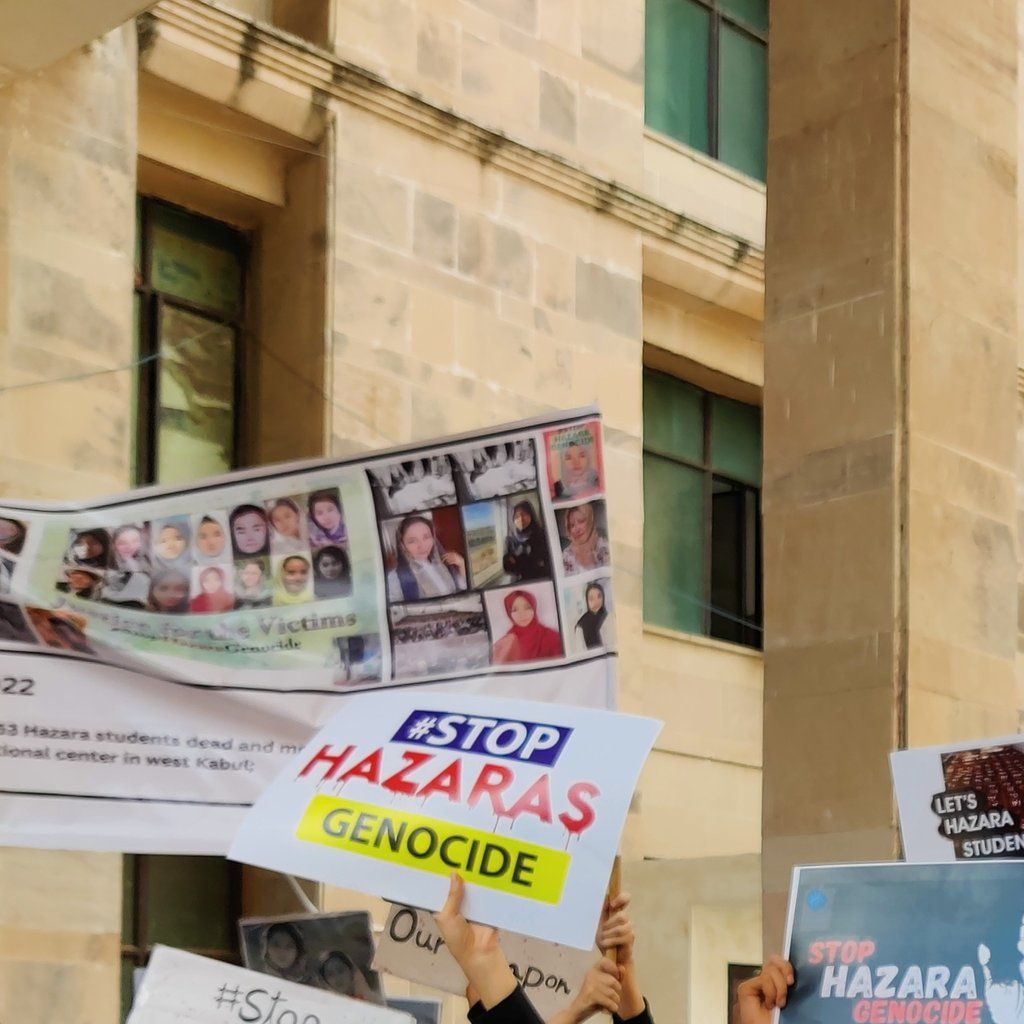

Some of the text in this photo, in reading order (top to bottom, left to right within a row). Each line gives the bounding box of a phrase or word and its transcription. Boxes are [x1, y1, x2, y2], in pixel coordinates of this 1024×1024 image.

[258, 610, 358, 638] Victims
[24, 725, 90, 741] Hazara
[95, 730, 180, 745] students
[187, 735, 233, 751] dead
[239, 740, 274, 754] and
[408, 716, 561, 761] #STOP
[0, 744, 50, 760] ional
[56, 748, 117, 764] center
[123, 752, 141, 765] in
[146, 755, 190, 768] west
[297, 743, 600, 836] HAZARAS
[936, 793, 978, 814] LET'S
[944, 811, 1014, 836] HAZARA
[322, 808, 540, 887] GENOCIDE
[389, 908, 445, 954] Our
[809, 941, 875, 965] STOP
[821, 964, 977, 1000] HAZARA
[853, 1000, 983, 1024] GENOCIDE
